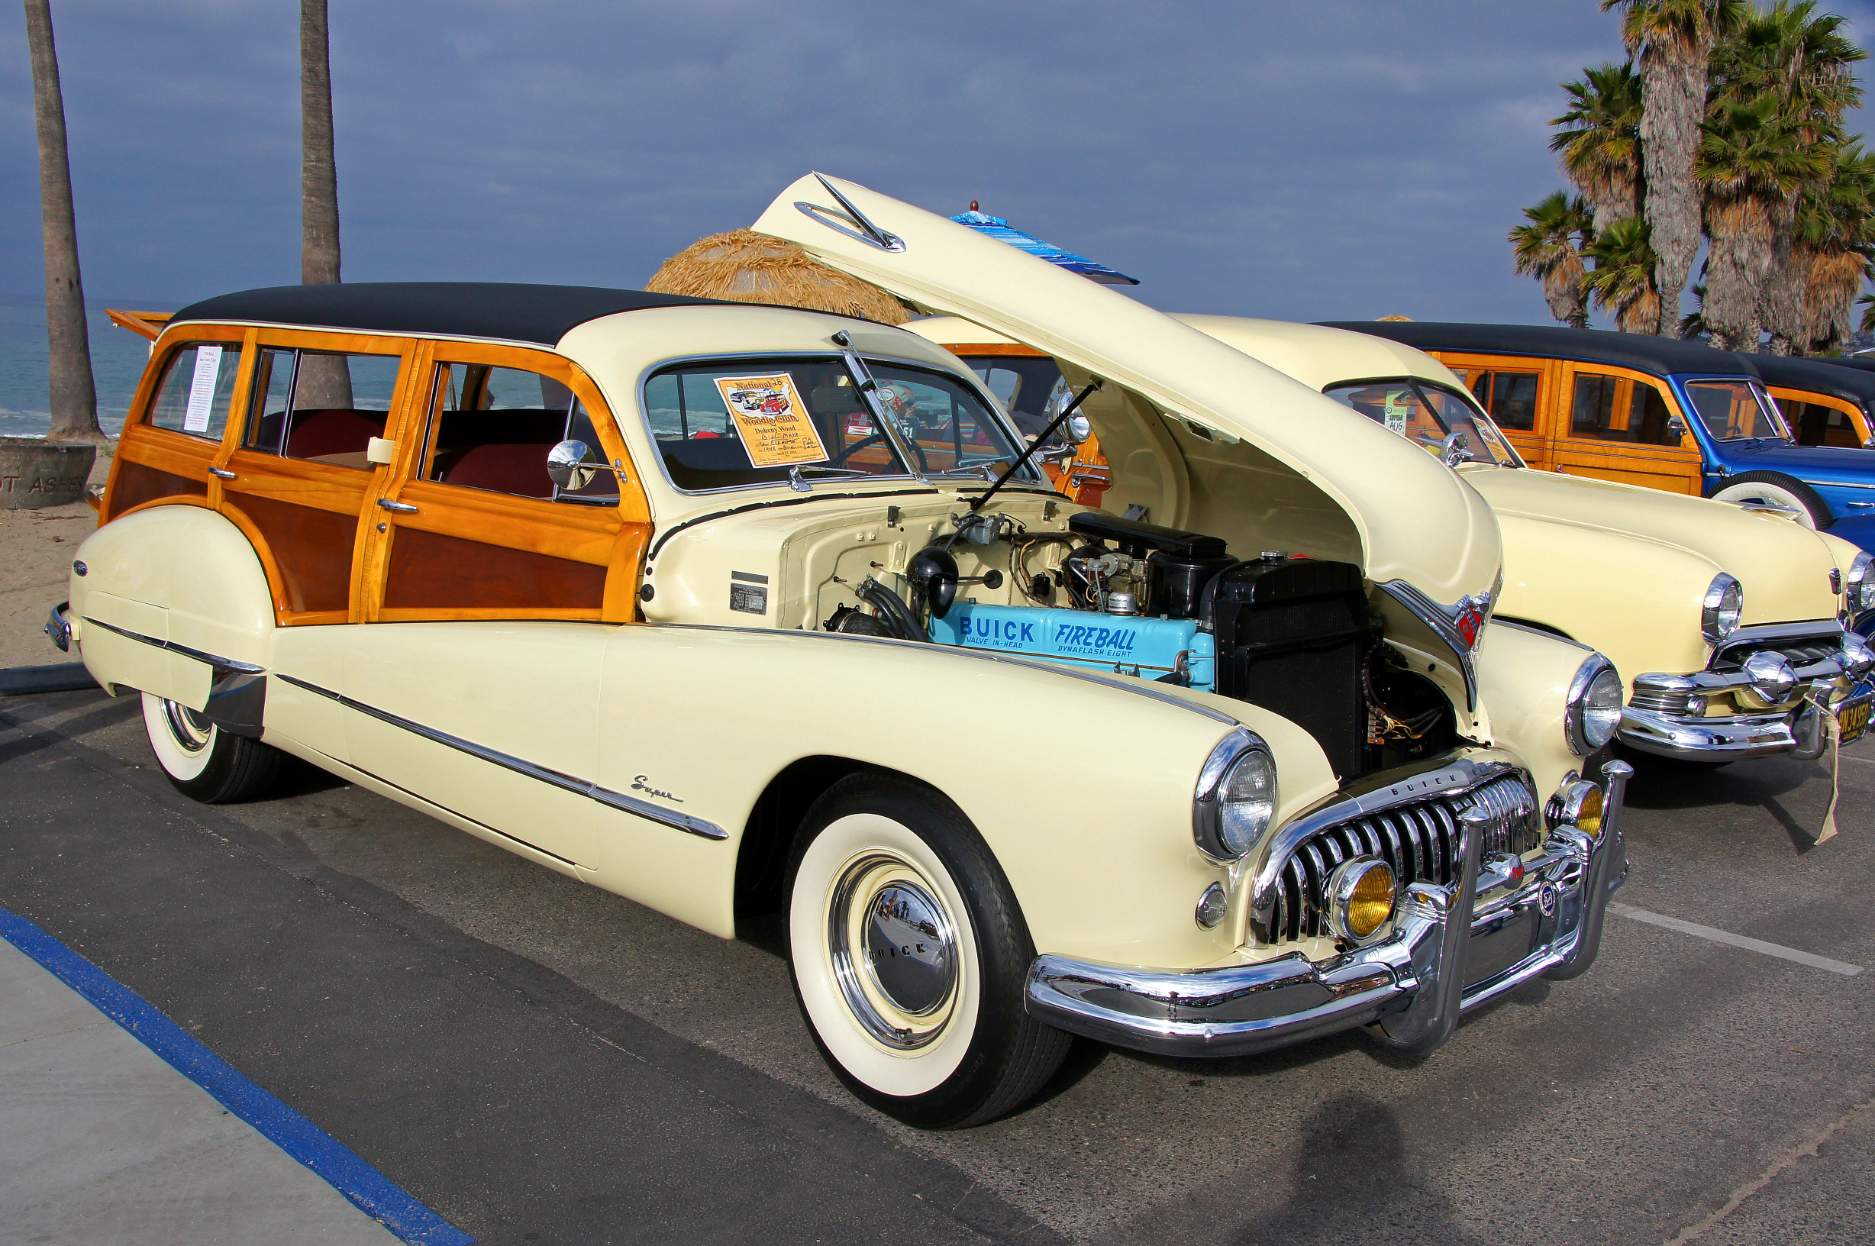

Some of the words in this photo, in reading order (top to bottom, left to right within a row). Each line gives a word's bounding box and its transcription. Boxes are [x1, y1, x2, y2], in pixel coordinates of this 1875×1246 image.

[735, 380, 772, 390] National
[960, 616, 1034, 643] BUICK
[1055, 623, 1136, 651] FIREBALL
[966, 636, 988, 645] VALVE
[1107, 649, 1132, 657] EIGHT
[631, 775, 684, 802] Super
[1391, 774, 1456, 796] BUICK
